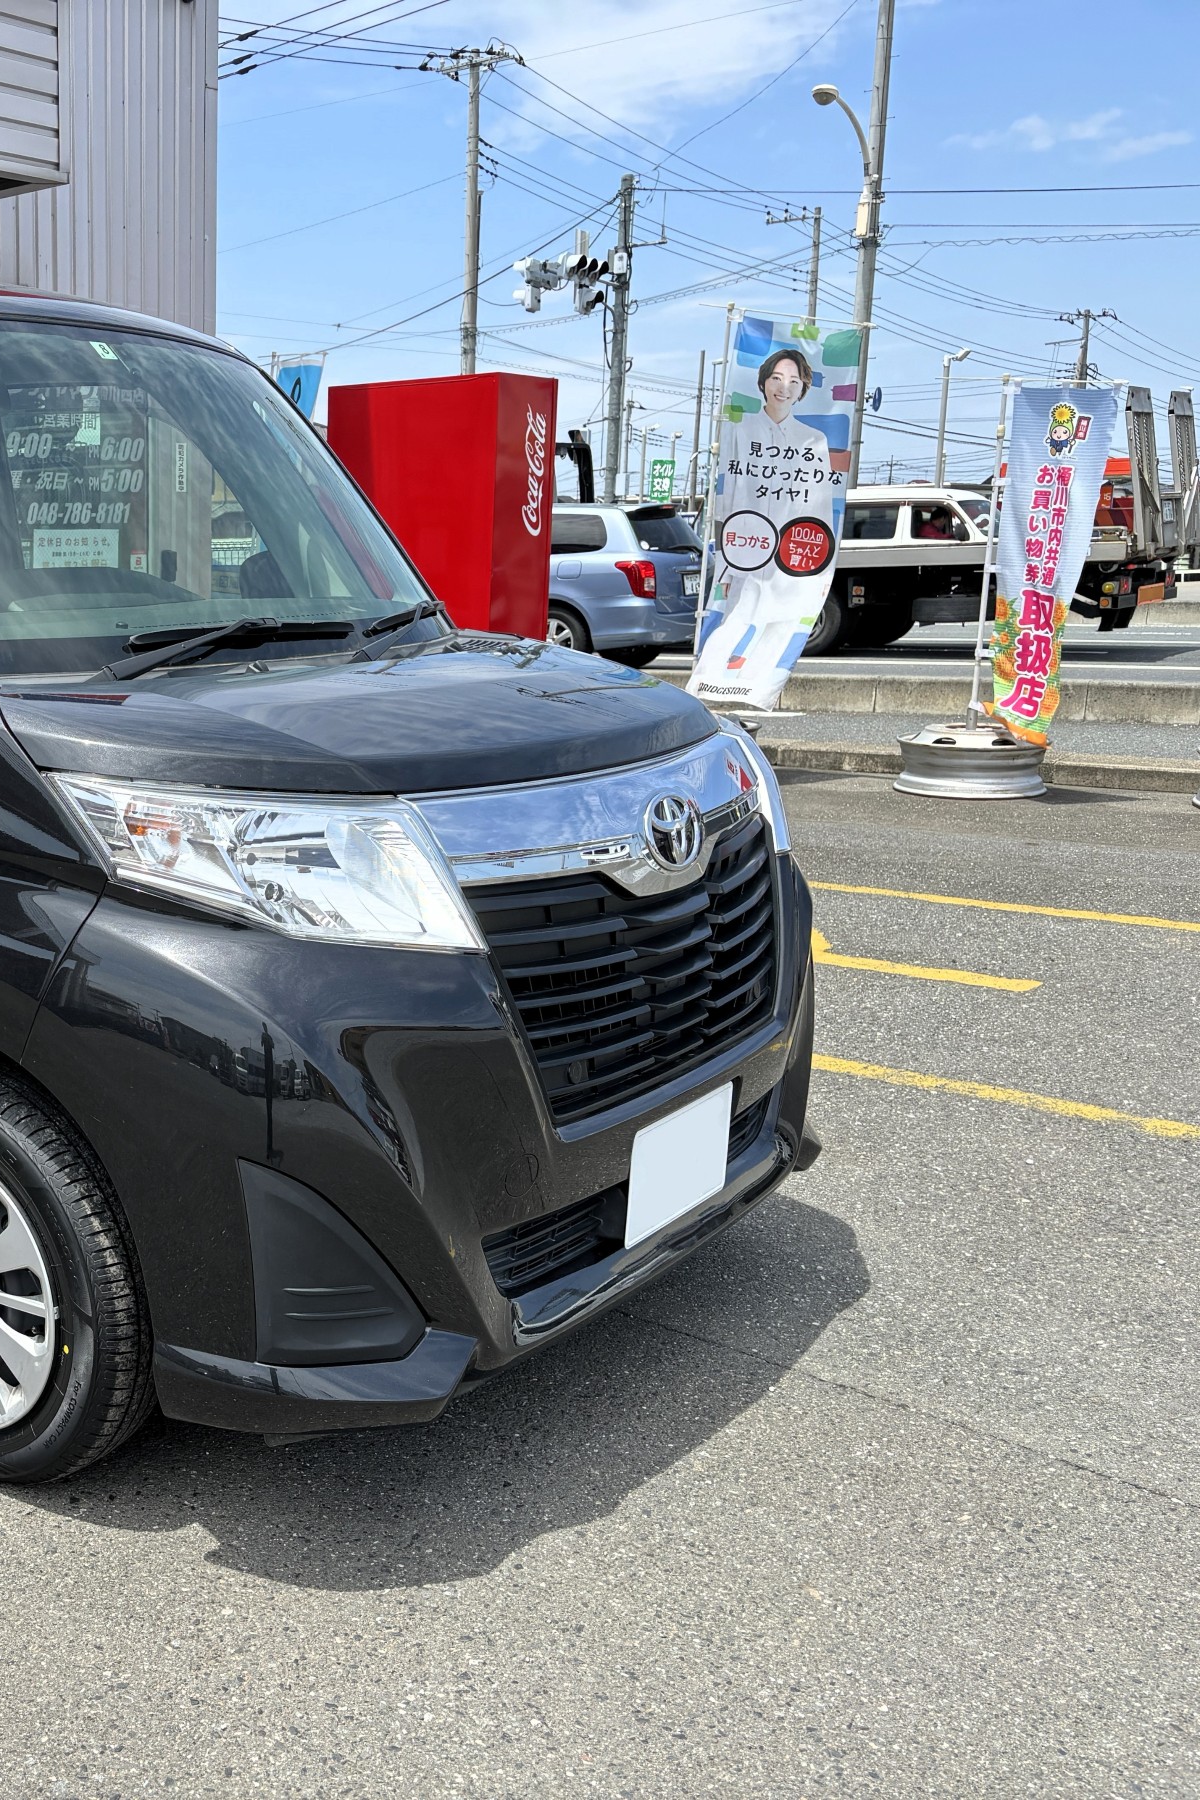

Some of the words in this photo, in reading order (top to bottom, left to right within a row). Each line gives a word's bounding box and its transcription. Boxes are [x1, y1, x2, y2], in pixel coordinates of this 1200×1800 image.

[43, 413, 97, 430] 営業時間
[6, 432, 53, 459] 9:00
[100, 437, 145, 462] 6:00
[749, 441, 823, 462] 見つかる、
[100, 469, 145, 493] 5:00
[653, 463, 674, 477] オイル
[728, 460, 843, 485] 私にぴったりな
[27, 502, 131, 525] 048-786-8181
[1025, 465, 1055, 582] お買い物券
[790, 527, 824, 542] 100人の
[1041, 466, 1073, 586] 桶川市内共通
[725, 532, 770, 550] 見つかる
[788, 542, 821, 558] ちゃんと
[1000, 589, 1055, 718] 取扱店
